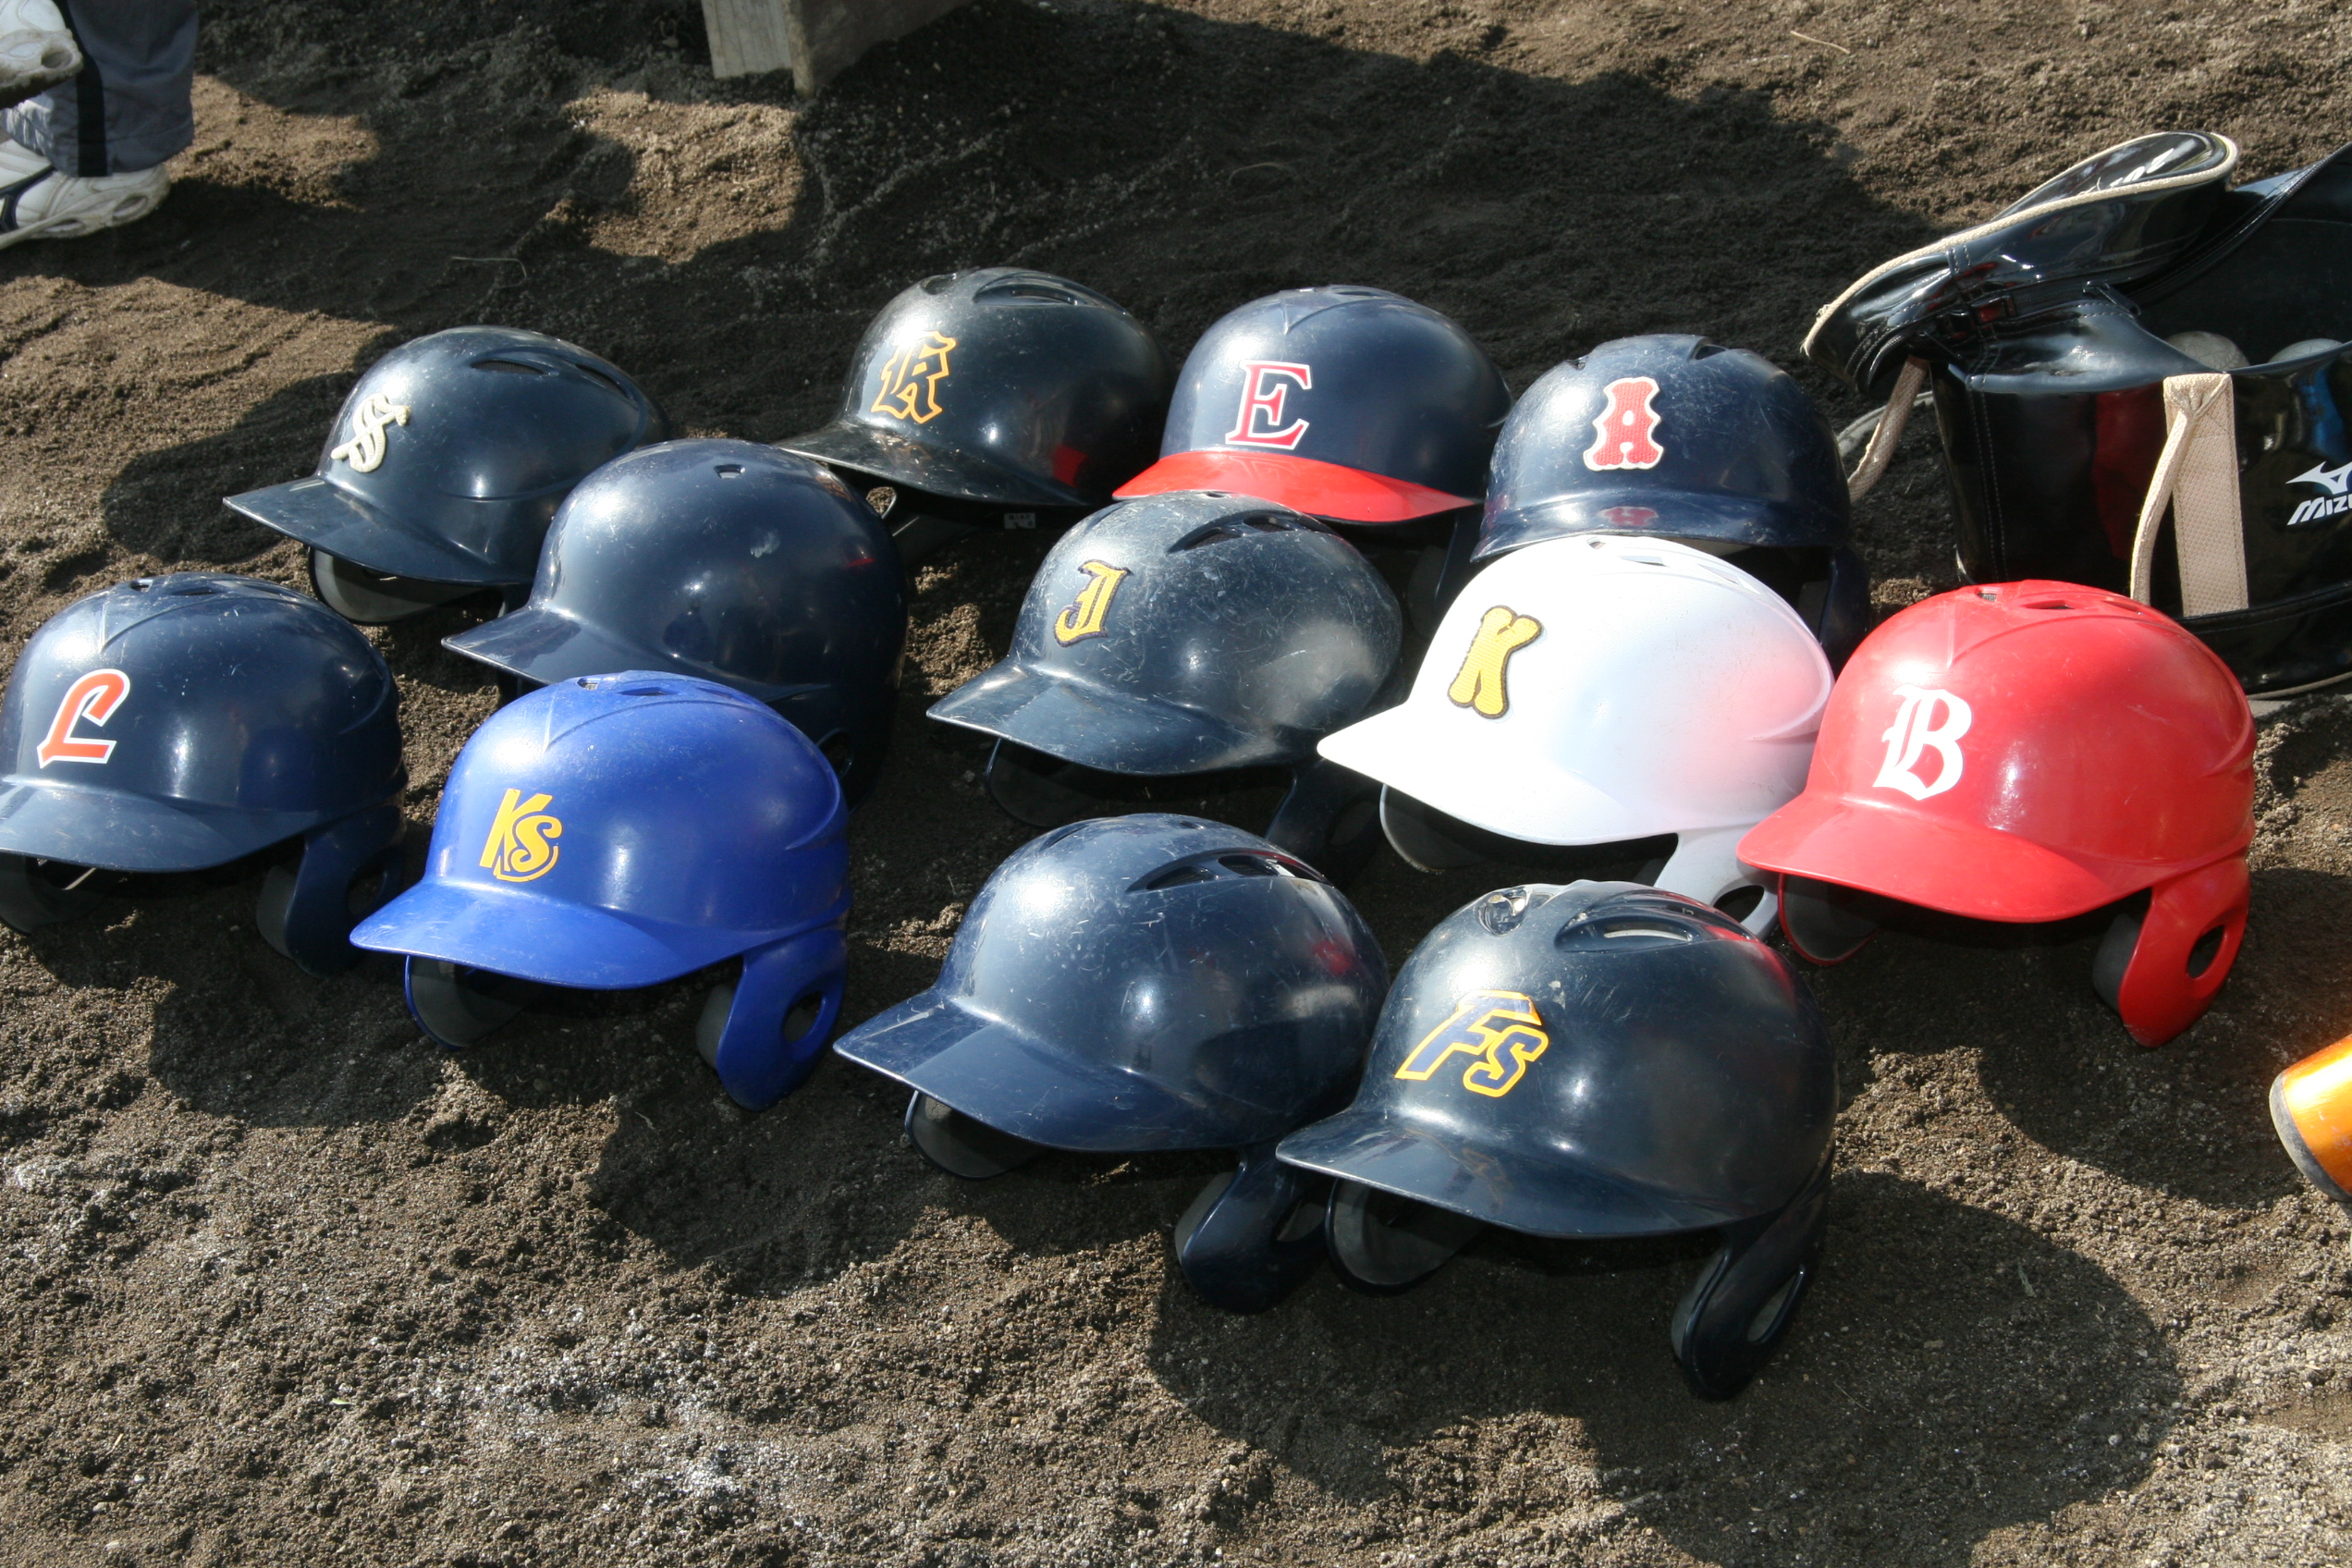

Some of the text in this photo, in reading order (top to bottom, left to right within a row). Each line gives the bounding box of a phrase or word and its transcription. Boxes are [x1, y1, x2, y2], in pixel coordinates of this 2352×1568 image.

[1225, 359, 1311, 448] E
[1583, 375, 1662, 470] A
[1447, 605, 1541, 718] K
[37, 668, 129, 768] L
[1872, 682, 1971, 800] B
